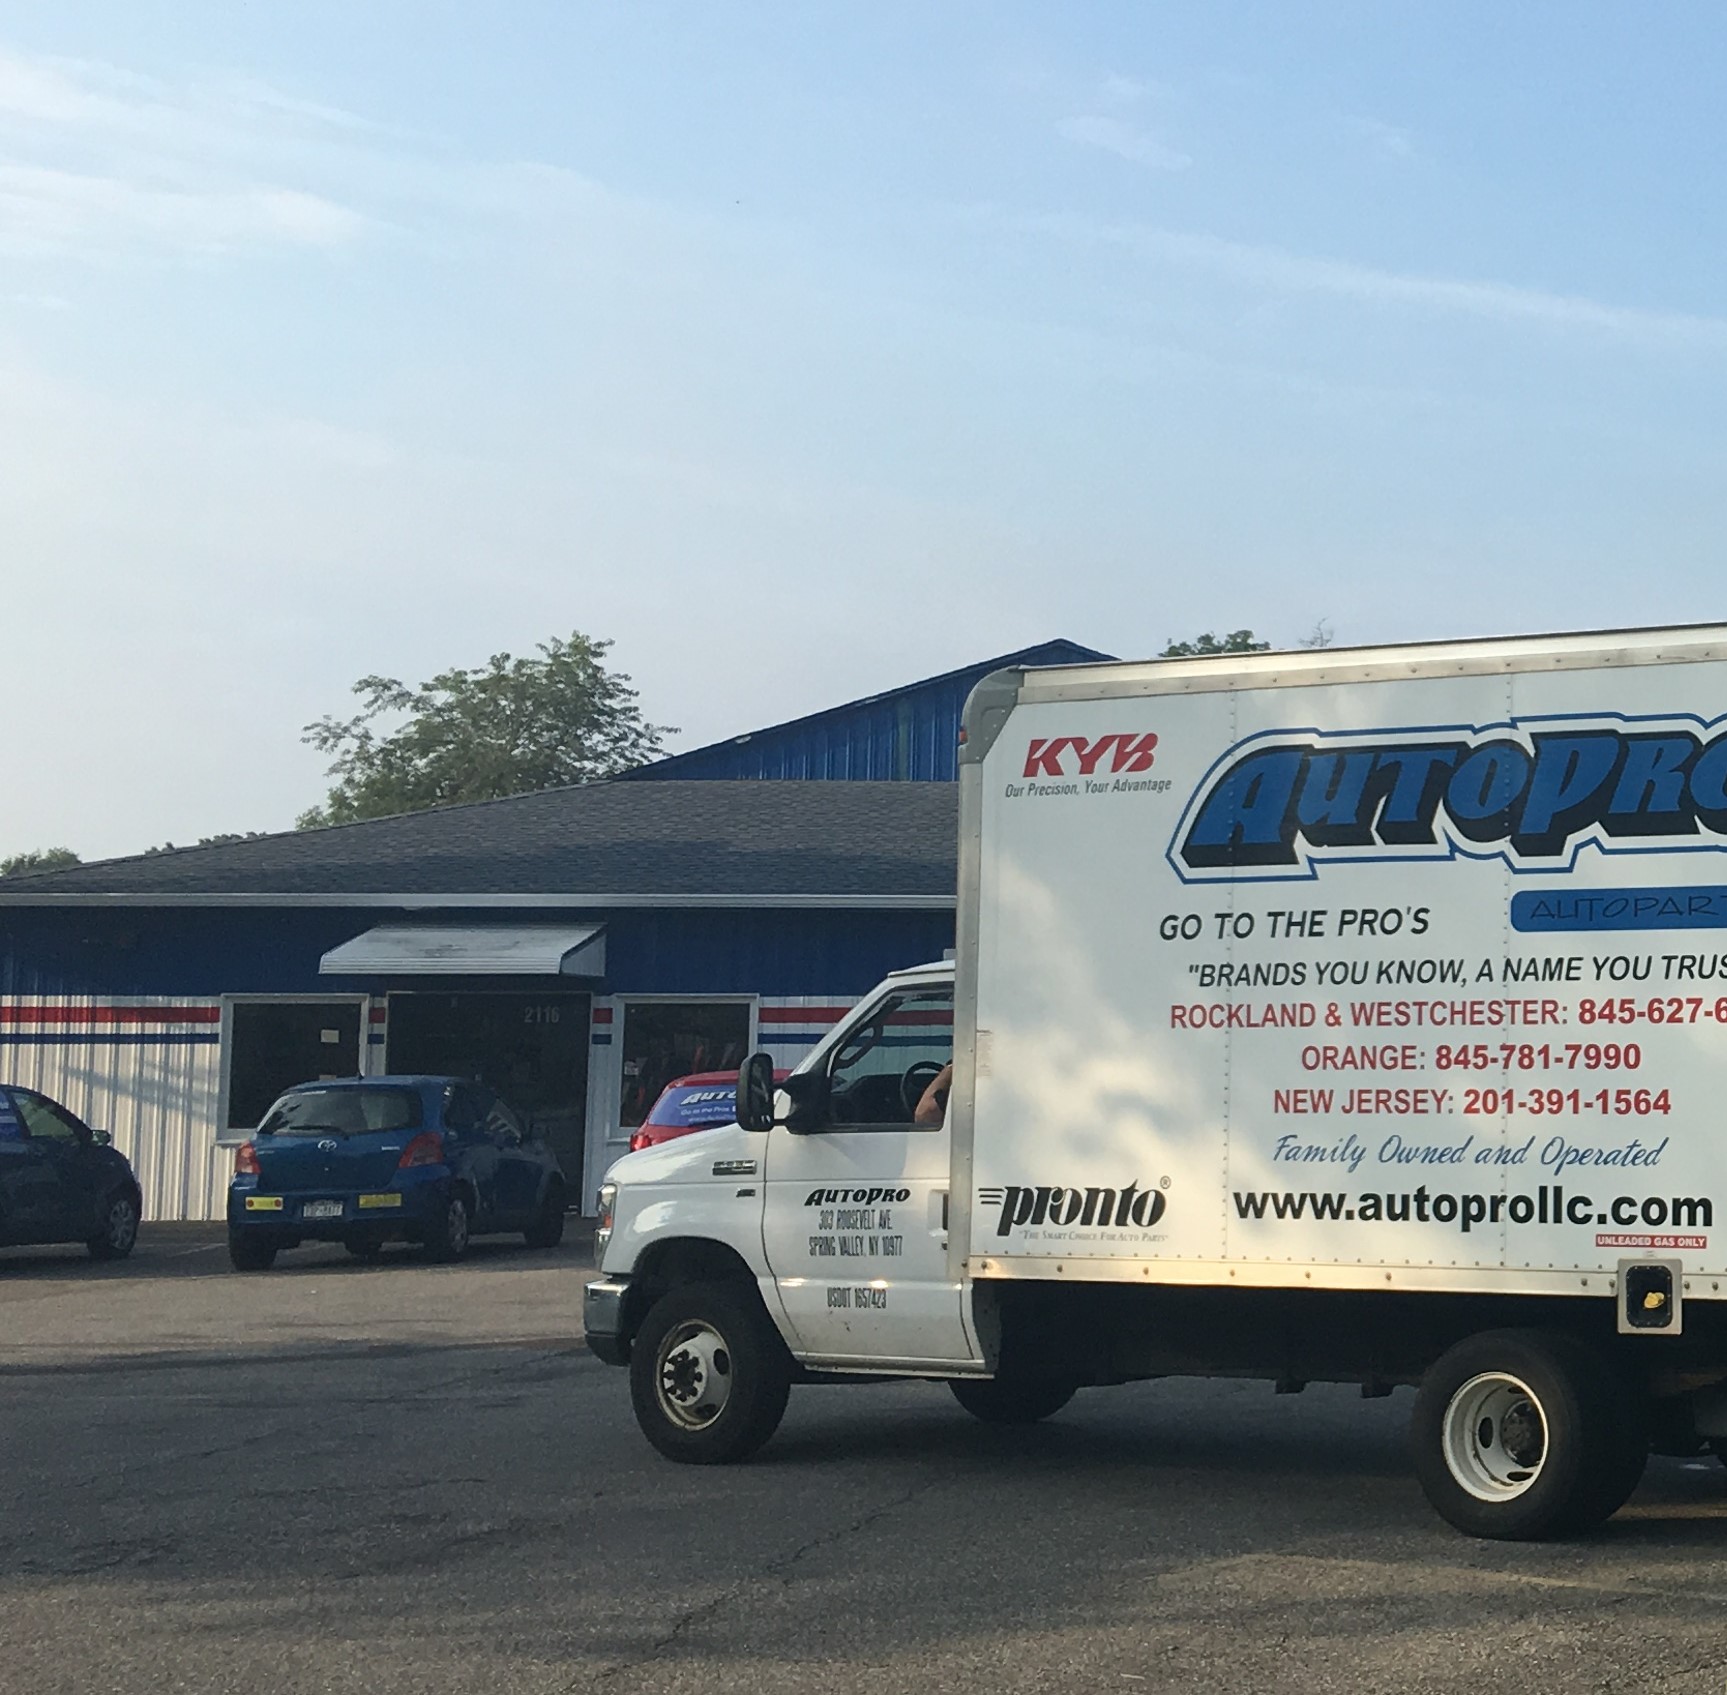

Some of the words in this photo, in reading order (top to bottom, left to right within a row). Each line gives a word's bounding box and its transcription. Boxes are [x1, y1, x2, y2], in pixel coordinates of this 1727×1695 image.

[1023, 732, 1159, 778] KYB
[1005, 783, 1026, 798] Our
[1027, 781, 1081, 798] Precision,
[1084, 780, 1110, 795] Your
[1111, 777, 1173, 796] Advantage
[1159, 914, 1202, 941] GO
[1214, 912, 1255, 939] TO
[1268, 909, 1327, 938] THE
[1338, 906, 1431, 937] PRO'S
[1188, 962, 1308, 988] "BRANDS
[1315, 961, 1369, 986] YOU
[1376, 959, 1469, 988] KNOW,
[1475, 959, 1496, 983] A
[1502, 956, 1584, 982] NAME
[1592, 955, 1653, 981] YOU
[524, 1005, 561, 1024] 2116
[1170, 1003, 1316, 1030] ROCKLAND
[1325, 1003, 1343, 1028] &
[1352, 999, 1568, 1028] WESTCHESTER:
[1301, 1045, 1427, 1071] ORANGE:
[1435, 1043, 1642, 1071] 845-781-7990
[1274, 1089, 1335, 1115] NEW
[1341, 1088, 1455, 1115] JERSEY:
[1463, 1088, 1672, 1116] 201-391-1564
[1272, 1133, 1368, 1174] Family
[1377, 1134, 1475, 1166] Owned
[1474, 1136, 1537, 1166] and
[1540, 1136, 1670, 1177] Operated
[836, 1208, 876, 1231] ROOSEVELT
[996, 1177, 1166, 1237] pronto
[1233, 1184, 1714, 1233] www.autoprollc.com
[868, 1235, 880, 1257] NY
[1597, 1235, 1651, 1247] UNLEADED
[1653, 1236, 1675, 1247] GAS
[1677, 1237, 1706, 1248] ONLY
